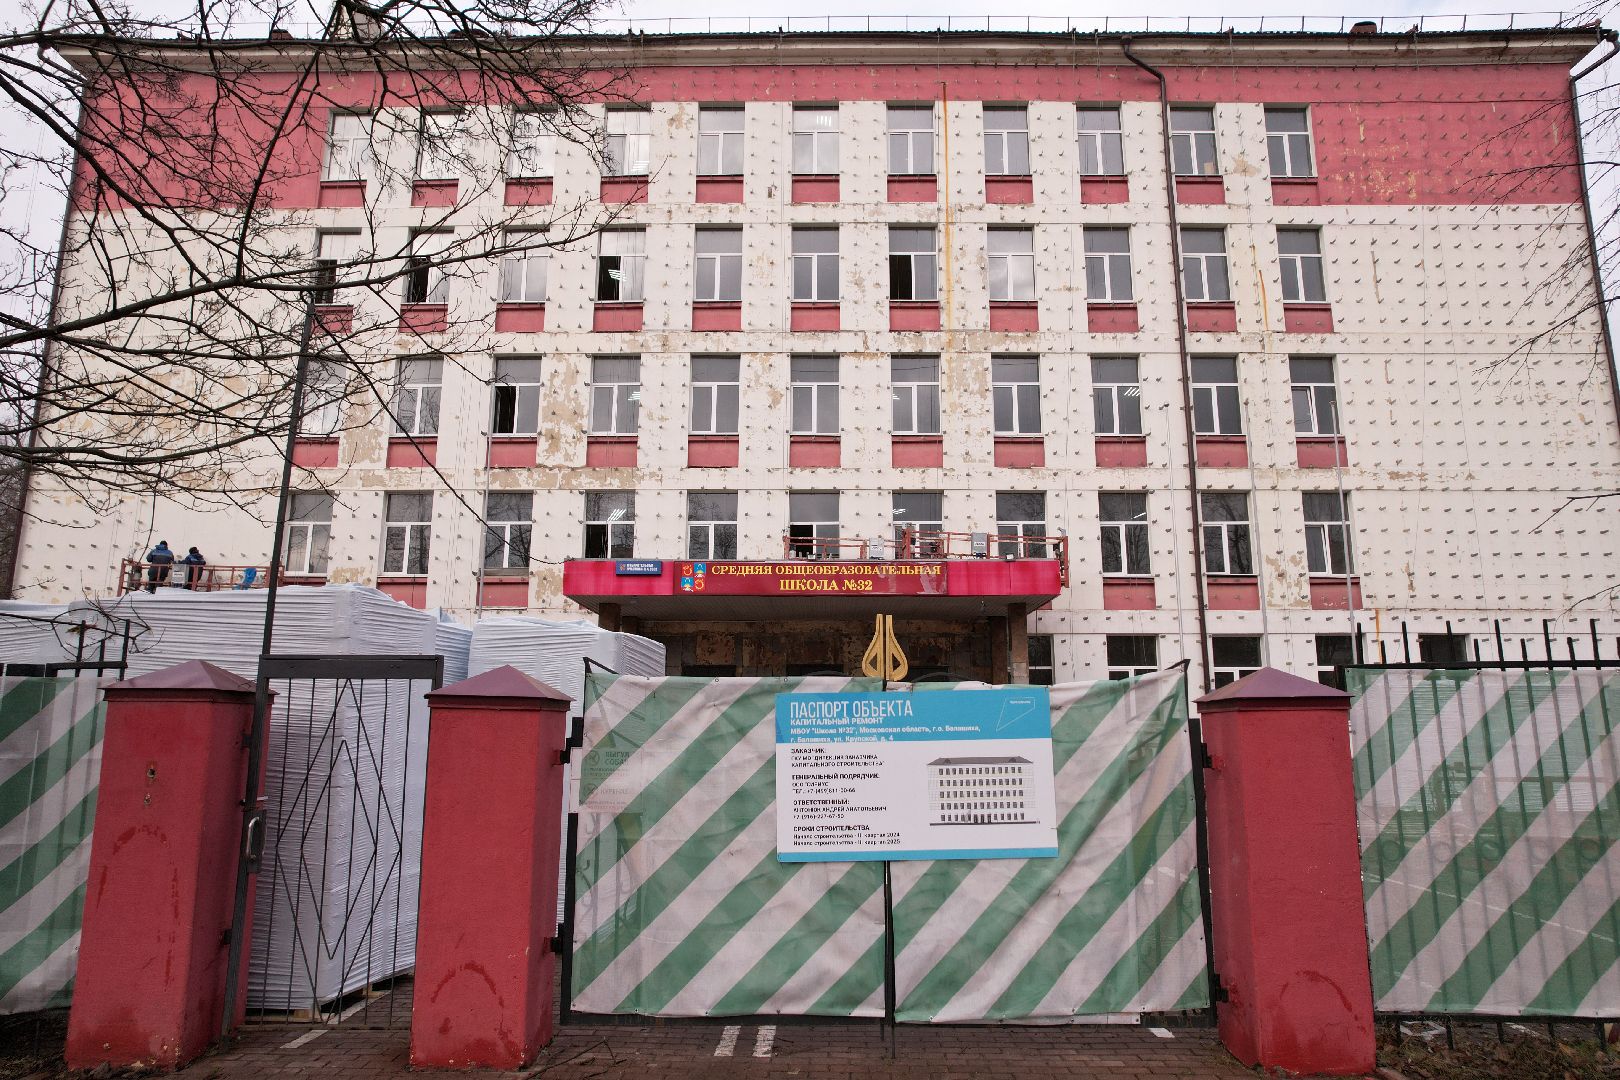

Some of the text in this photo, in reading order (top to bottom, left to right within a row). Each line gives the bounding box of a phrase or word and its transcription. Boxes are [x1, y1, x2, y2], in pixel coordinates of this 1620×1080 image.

[711, 564, 941, 577] СРЕДНЯЯ ОБЩЕОБРАЗОВАТЕЛЬНАЯ
[779, 579, 873, 591] ШКОЛА №32
[790, 699, 913, 719] ПАСПОРТ ОБЪЕКТА
[790, 716, 883, 726] КАПИТАЛЬНЫЙ РЕМОНТ
[790, 727, 811, 735] МБОУ
[901, 725, 931, 733] область,
